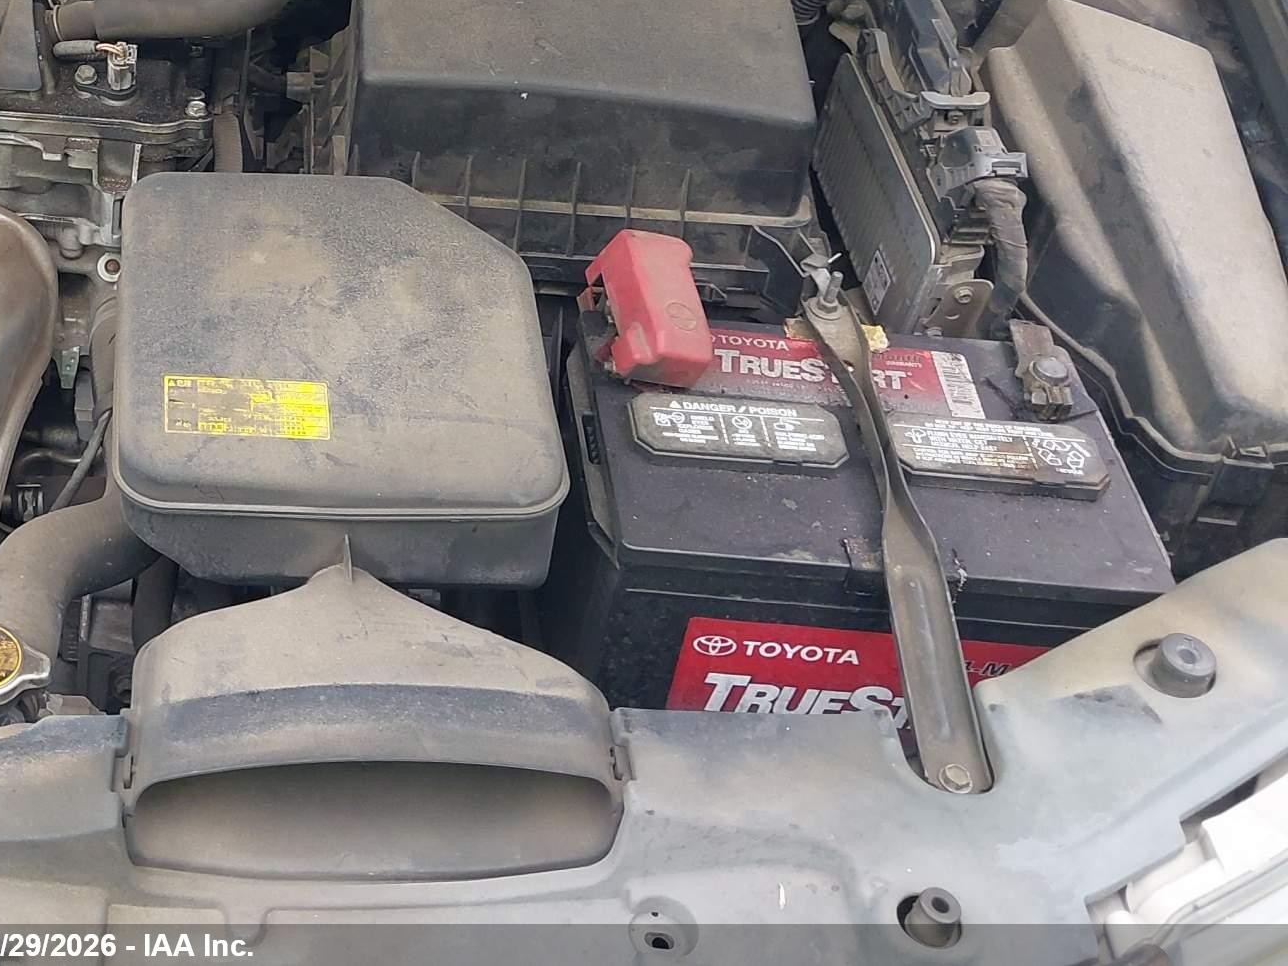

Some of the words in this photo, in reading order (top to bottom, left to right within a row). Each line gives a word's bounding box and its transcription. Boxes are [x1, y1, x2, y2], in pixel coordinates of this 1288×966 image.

[718, 334, 790, 352] TOYOTA
[714, 348, 906, 391] TRUESRT
[683, 401, 736, 414] DANGER
[738, 405, 747, 414] /
[748, 406, 798, 418] POISON
[743, 640, 860, 665] TOYOTA
